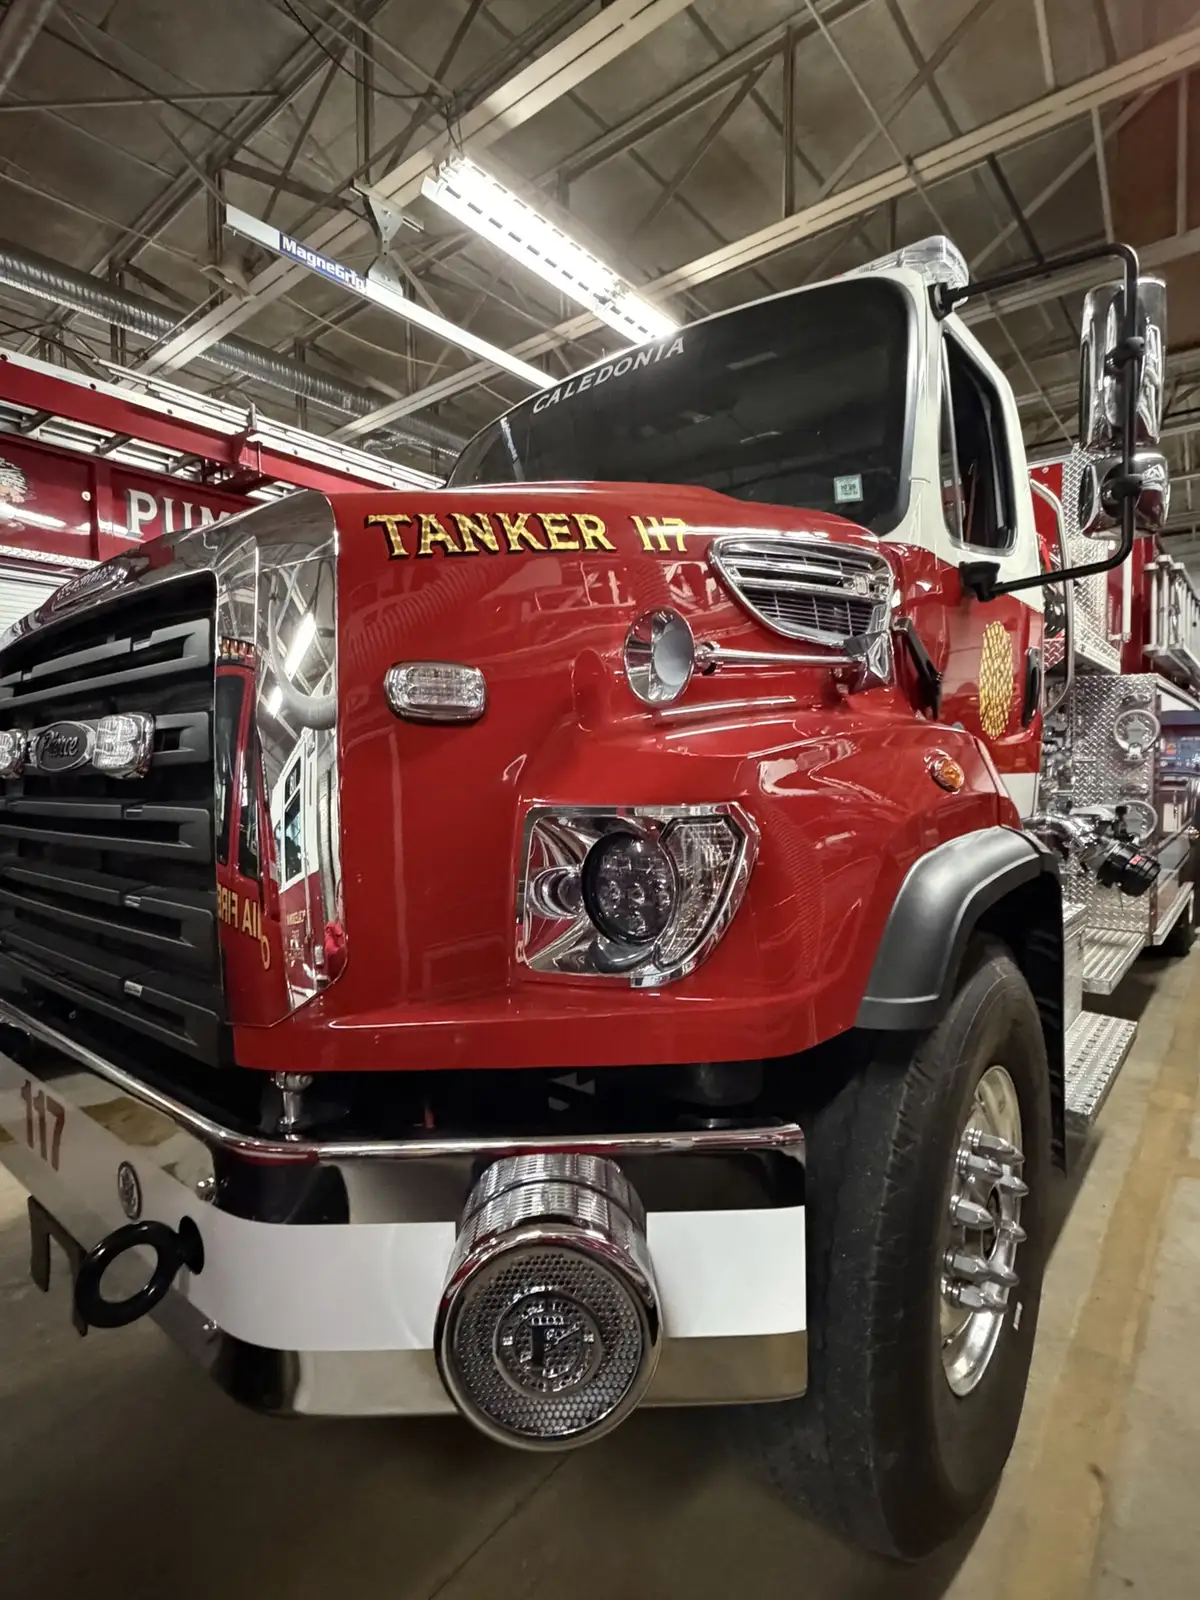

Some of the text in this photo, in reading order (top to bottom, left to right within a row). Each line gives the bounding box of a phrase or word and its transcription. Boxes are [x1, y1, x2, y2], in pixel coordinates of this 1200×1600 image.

[532, 336, 685, 414] CALEDONIA
[364, 512, 689, 560] TANKER 117
[21, 1079, 66, 1173] 117
